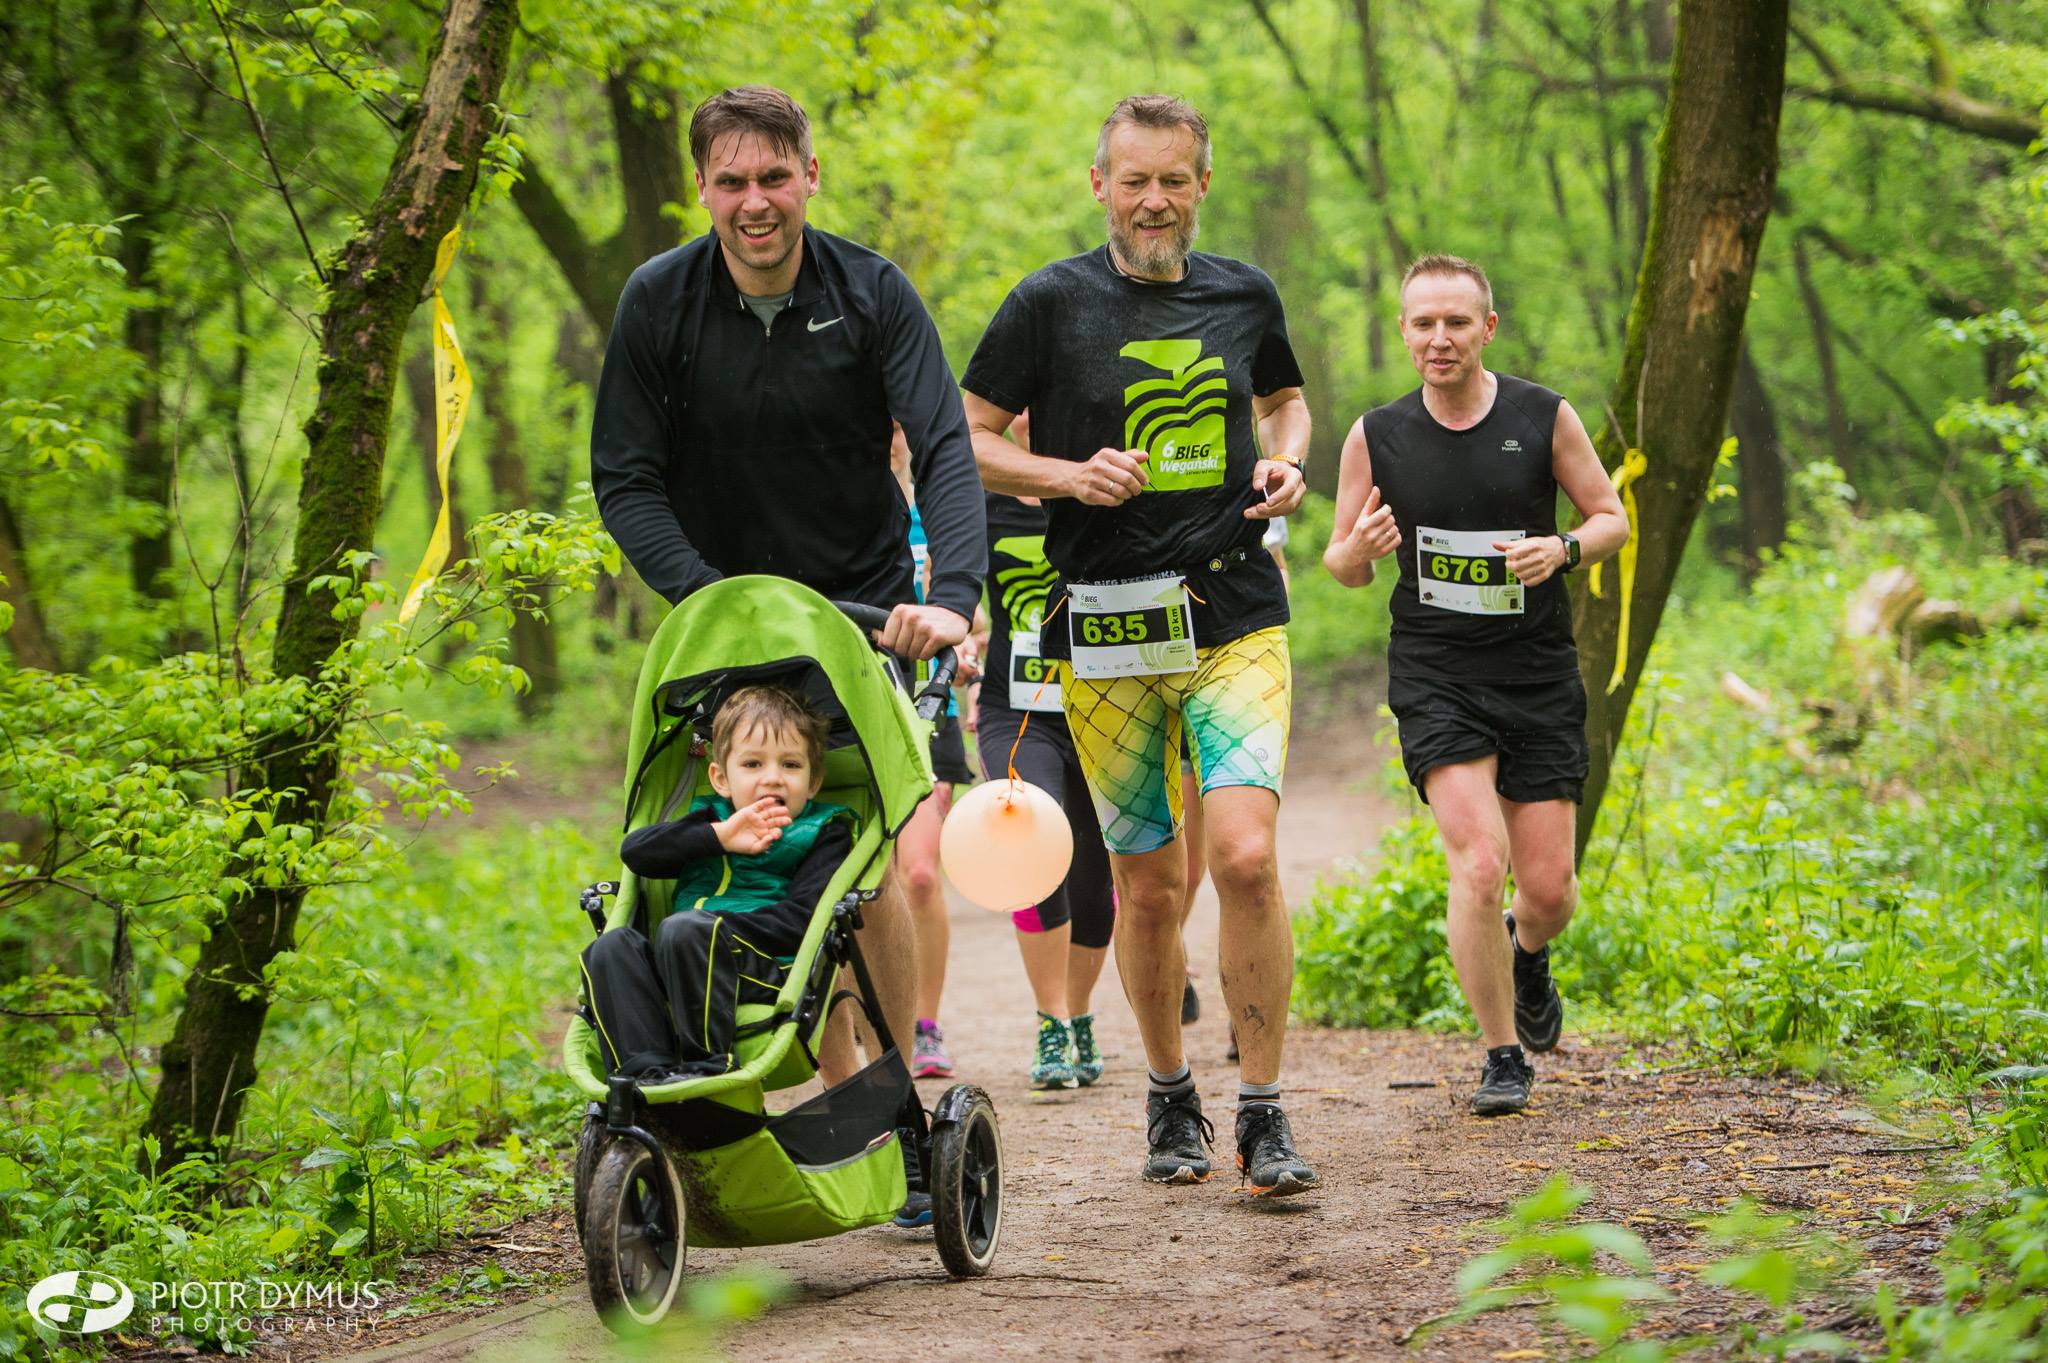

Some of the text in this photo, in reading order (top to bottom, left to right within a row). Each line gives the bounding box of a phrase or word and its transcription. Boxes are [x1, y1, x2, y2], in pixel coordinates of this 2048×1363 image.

[1162, 440, 1211, 460] 6 BIEG
[1431, 555, 1489, 583] 676
[1082, 614, 1148, 644] 635
[1172, 608, 1181, 638] 10 km
